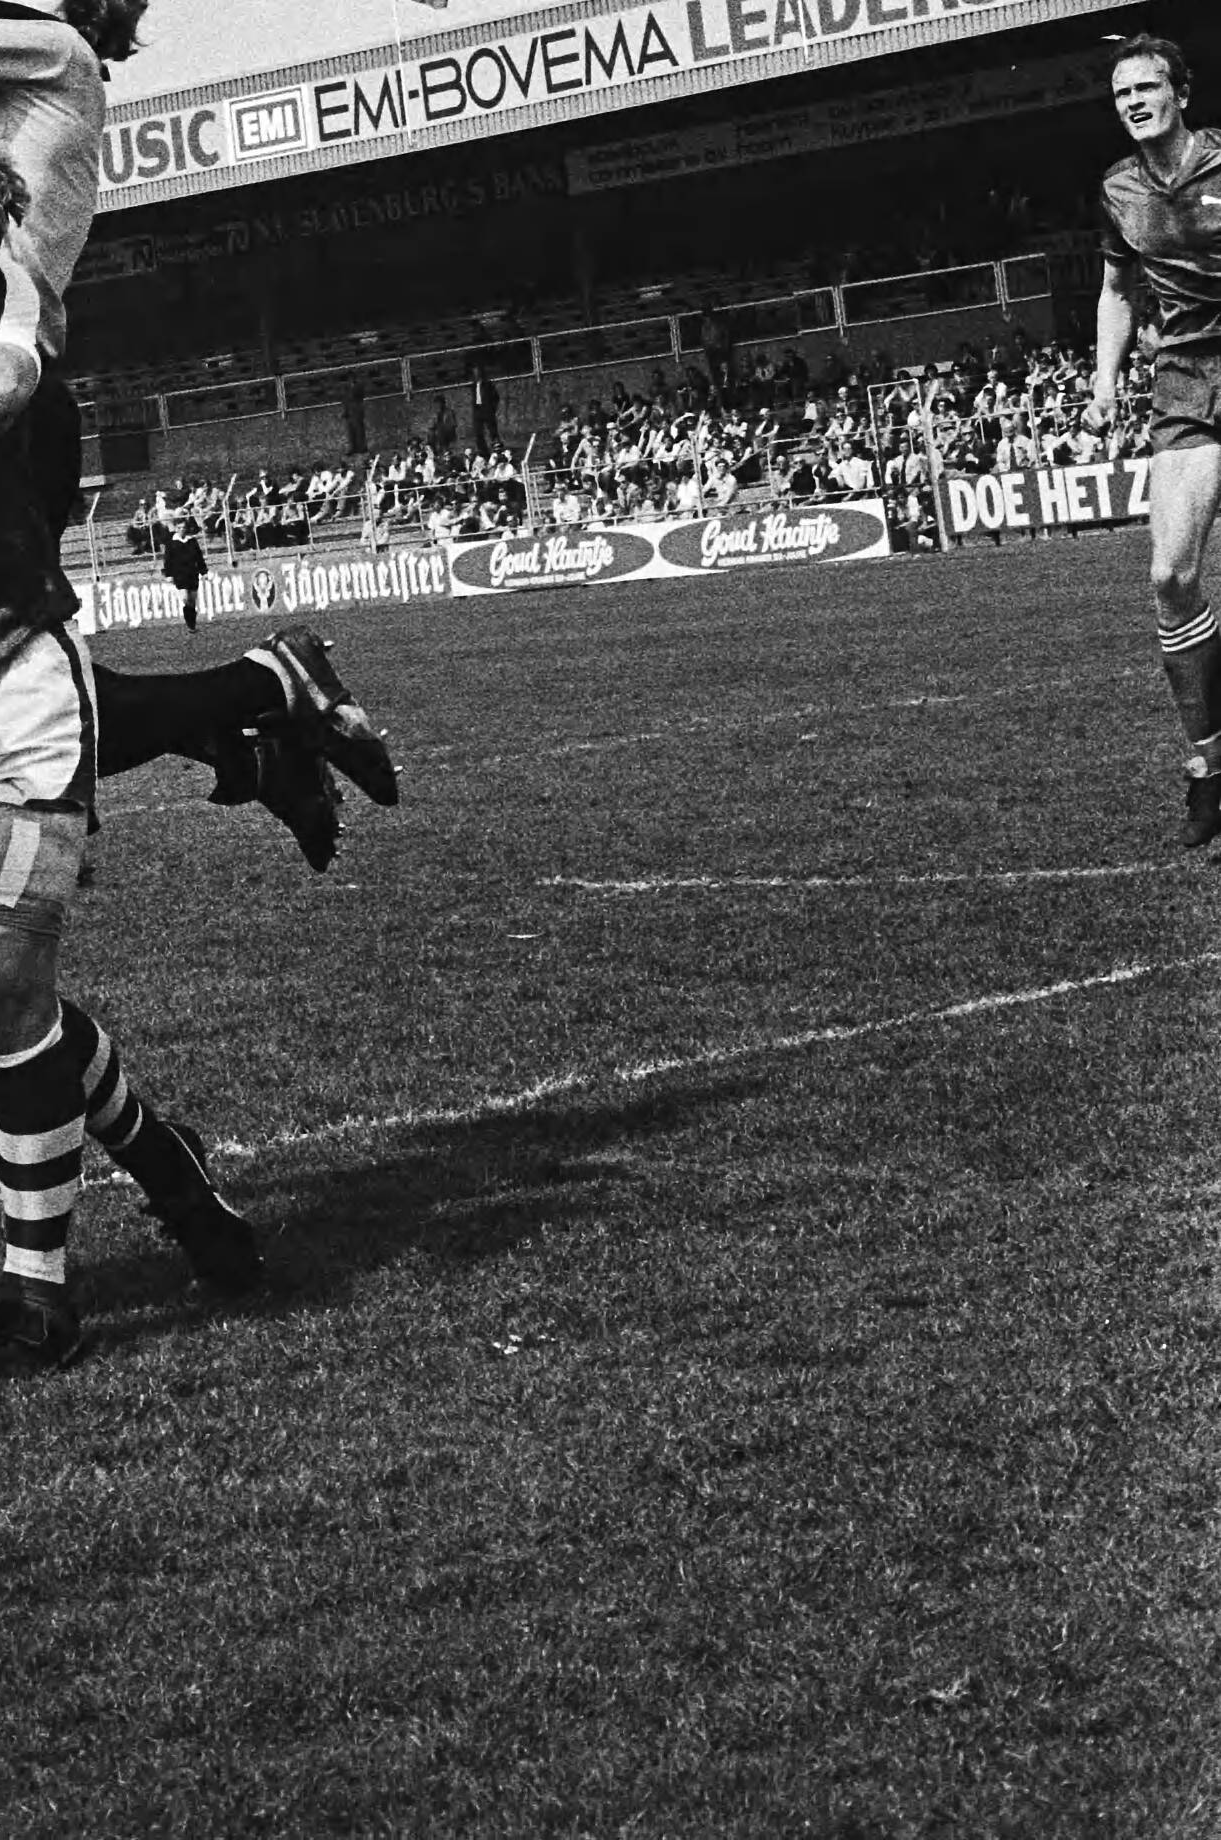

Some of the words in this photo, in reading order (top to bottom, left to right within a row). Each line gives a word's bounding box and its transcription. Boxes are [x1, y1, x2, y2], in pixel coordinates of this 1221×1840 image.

[314, 10, 679, 143] EMI-BOVEMA
[241, 106, 297, 146] EMI
[947, 472, 1030, 533] DOE
[1036, 461, 1115, 524] HET
[490, 541, 541, 587] Goud
[700, 519, 758, 567] Goud
